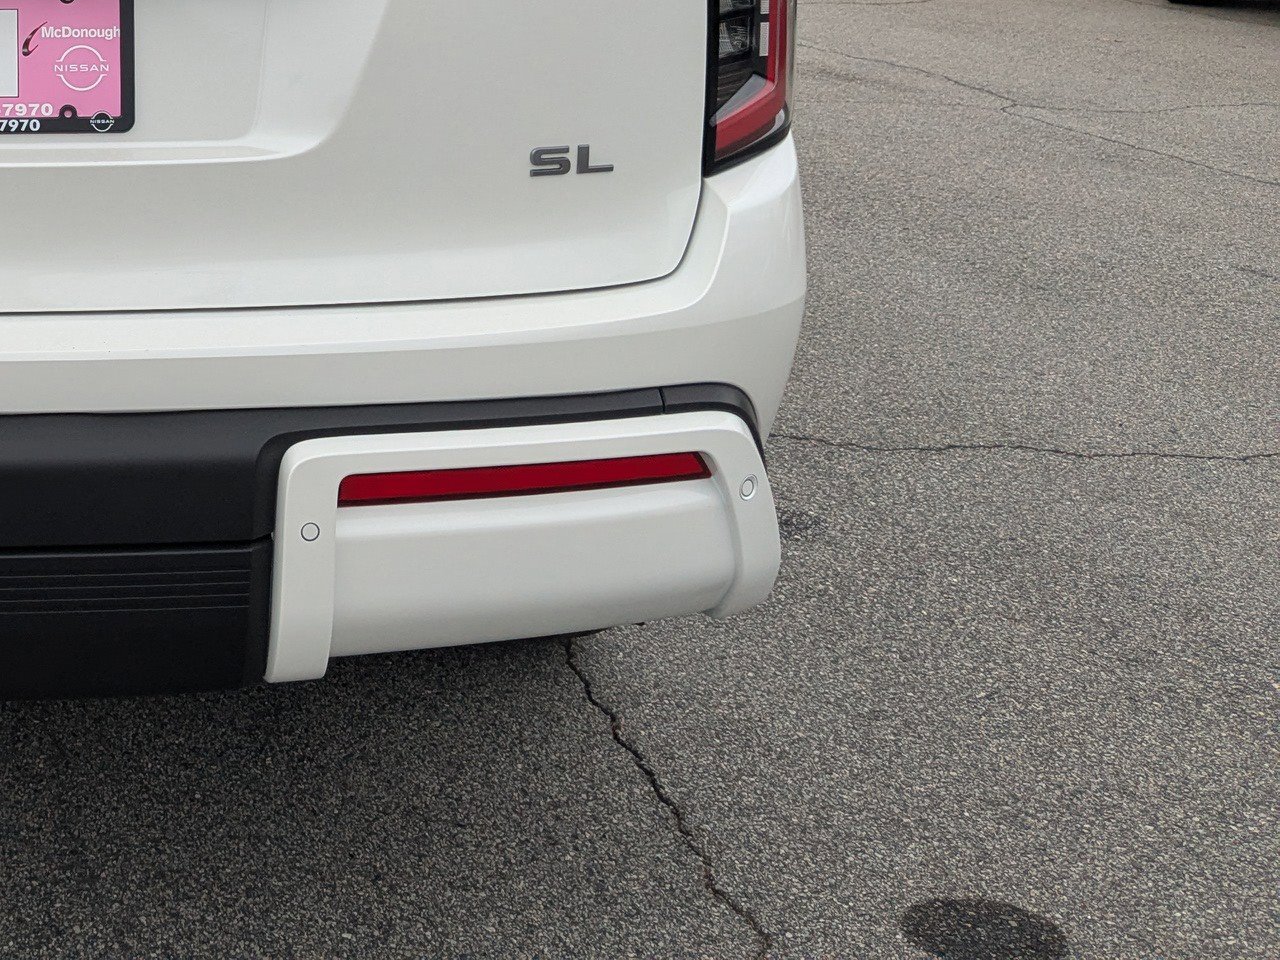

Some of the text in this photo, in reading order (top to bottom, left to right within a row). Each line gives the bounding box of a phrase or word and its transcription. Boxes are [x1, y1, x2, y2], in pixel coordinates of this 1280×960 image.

[41, 26, 120, 39] McDonough
[54, 63, 109, 72] NISSAN
[529, 143, 614, 178] SL
